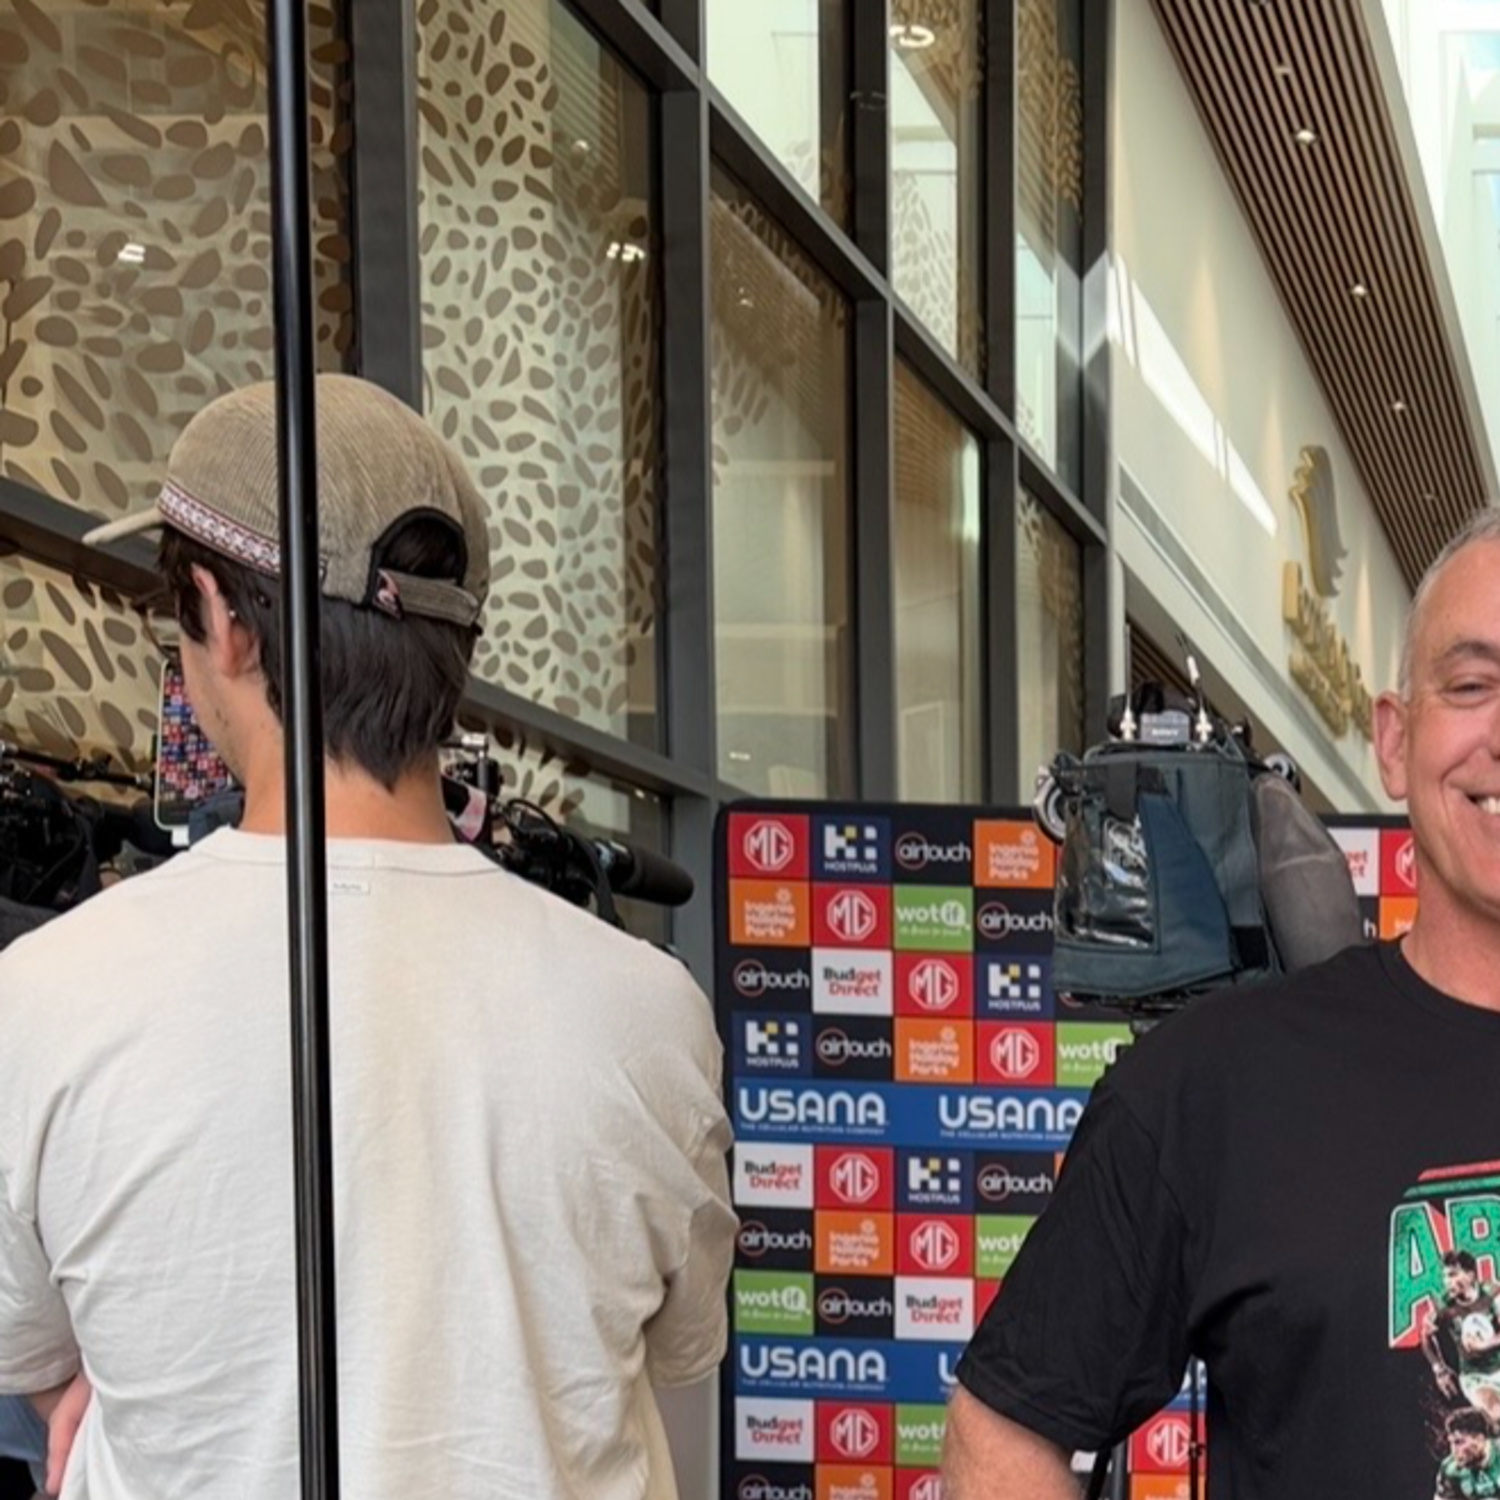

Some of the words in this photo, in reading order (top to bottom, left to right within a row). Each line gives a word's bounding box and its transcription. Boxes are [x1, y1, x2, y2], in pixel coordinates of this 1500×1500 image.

[747, 823, 791, 868] MG
[900, 841, 971, 862] airtouch
[824, 861, 877, 873] HOSTPLUS
[831, 893, 873, 937] MG
[981, 911, 1052, 931] airtouch
[738, 968, 810, 988] airtouch
[823, 967, 881, 984] Budget
[912, 962, 955, 1006] MG
[829, 982, 879, 997] Direct
[988, 1000, 1041, 1011] HOSTPLUS
[820, 1036, 892, 1057] airtouch
[993, 1031, 1036, 1075] MG
[746, 1056, 799, 1068] HOSTPLUS
[739, 1087, 886, 1126] USANA
[938, 1095, 1085, 1132] USANA
[744, 1160, 803, 1178] Budget
[833, 1157, 875, 1200] MG
[750, 1175, 799, 1190] Direct
[981, 1173, 1053, 1193] airtouch
[908, 1192, 961, 1204] HOSTPLUS
[739, 1229, 812, 1249] airtouch
[914, 1224, 956, 1267] MG
[821, 1296, 892, 1316] airtouch
[906, 1295, 963, 1312] Budget
[911, 1309, 961, 1324] Direct
[740, 1344, 886, 1382] USANA
[746, 1415, 803, 1433] Budget
[834, 1412, 875, 1454] MG
[752, 1430, 801, 1444] Direct
